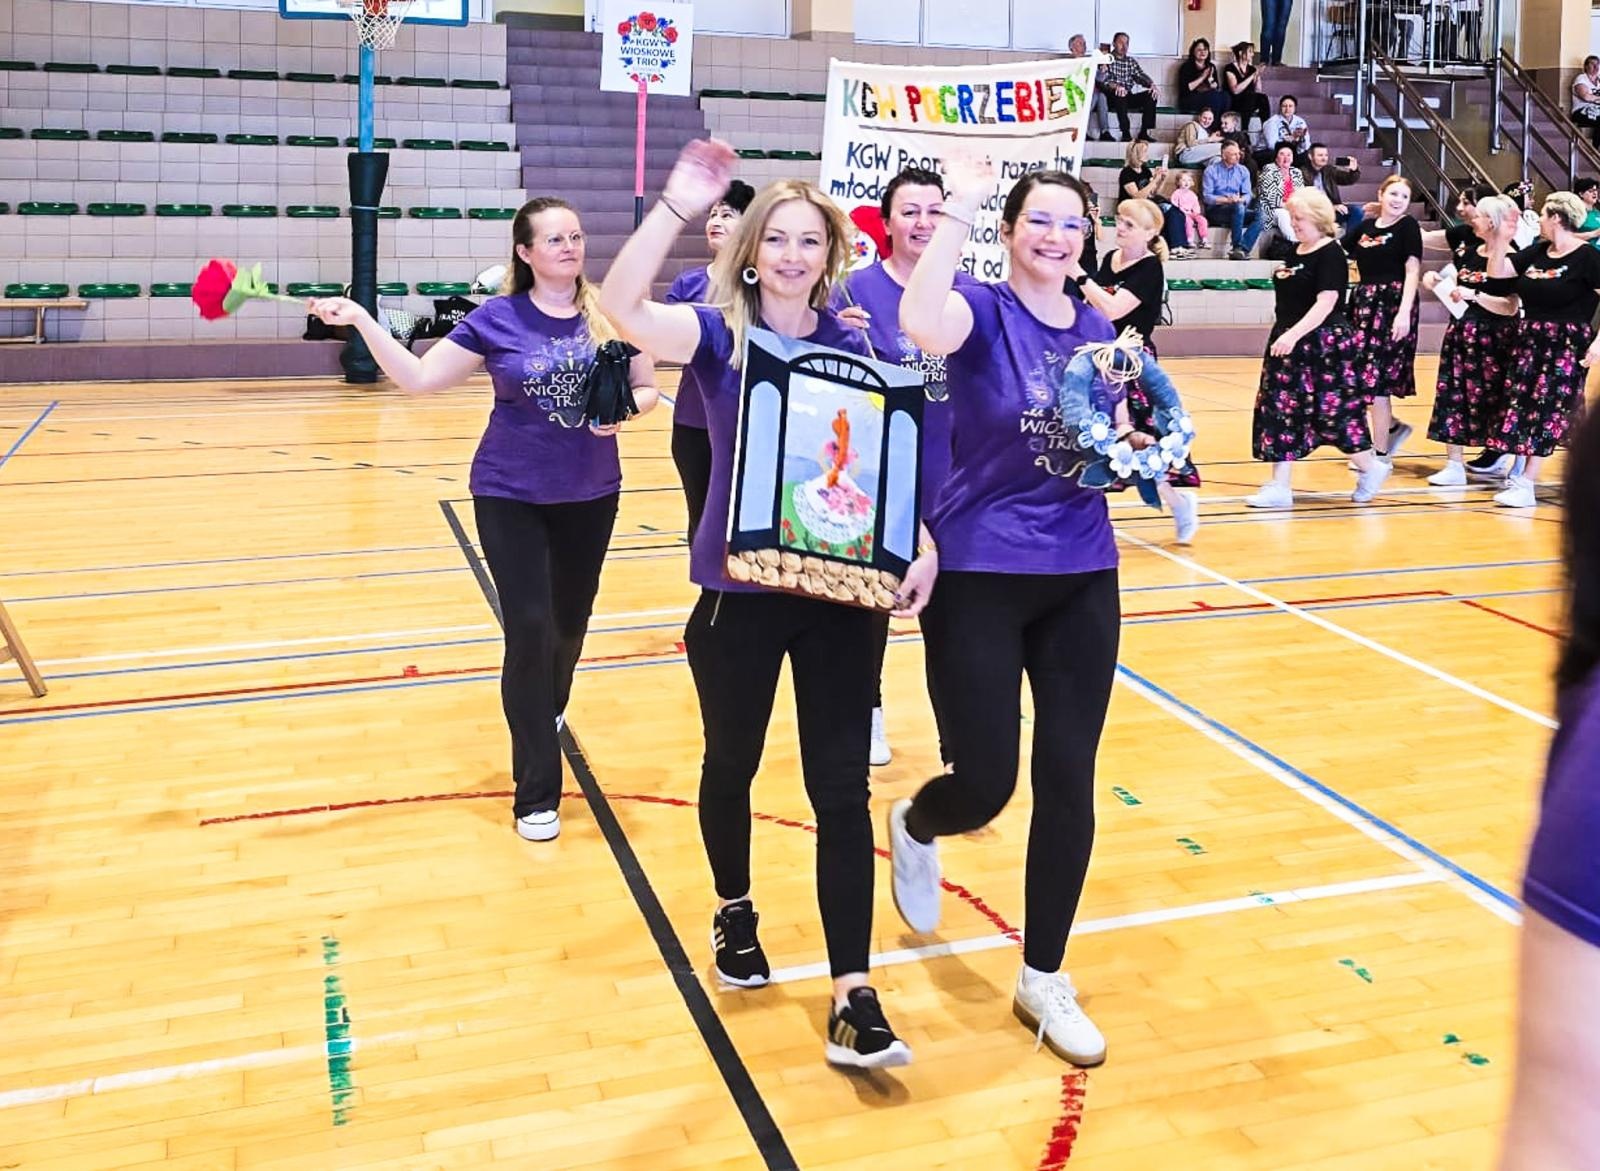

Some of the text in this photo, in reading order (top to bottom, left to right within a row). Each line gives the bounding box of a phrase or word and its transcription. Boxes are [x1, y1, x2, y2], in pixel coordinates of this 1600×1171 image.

[635, 38, 660, 47] KGW
[620, 46, 675, 58] WIOSKOWE
[637, 57, 659, 66] TRIO
[846, 141, 892, 171] KGW
